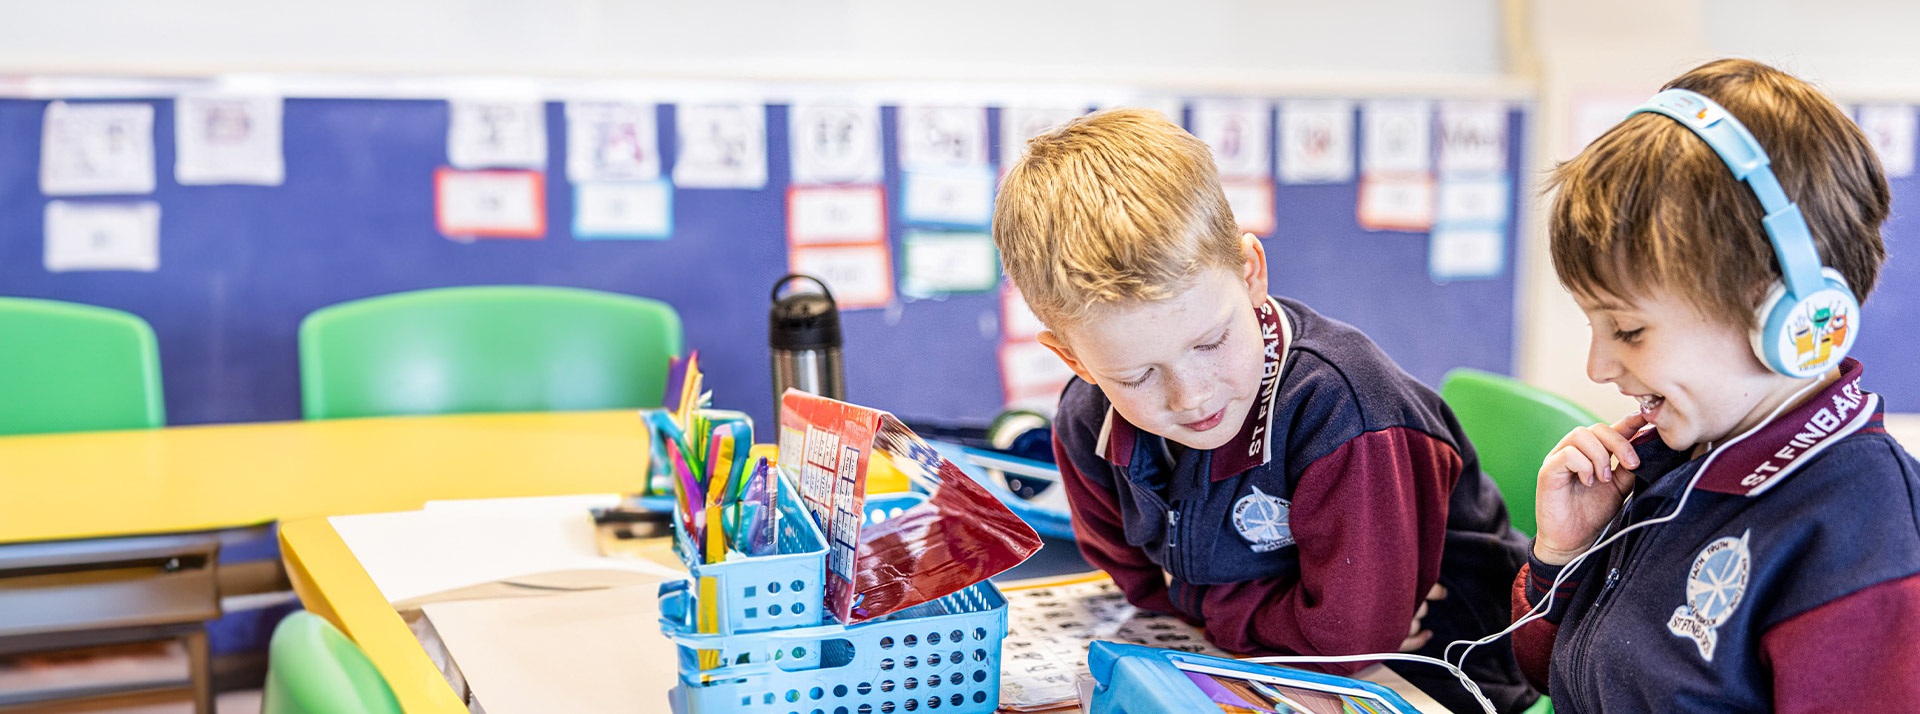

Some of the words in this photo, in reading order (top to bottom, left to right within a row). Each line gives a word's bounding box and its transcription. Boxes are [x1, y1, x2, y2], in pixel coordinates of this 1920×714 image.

[1249, 426, 1264, 457] ST
[1258, 302, 1280, 420] FINBAR'S
[1740, 461, 1780, 487] ST
[1706, 541, 1729, 555] TRUTH
